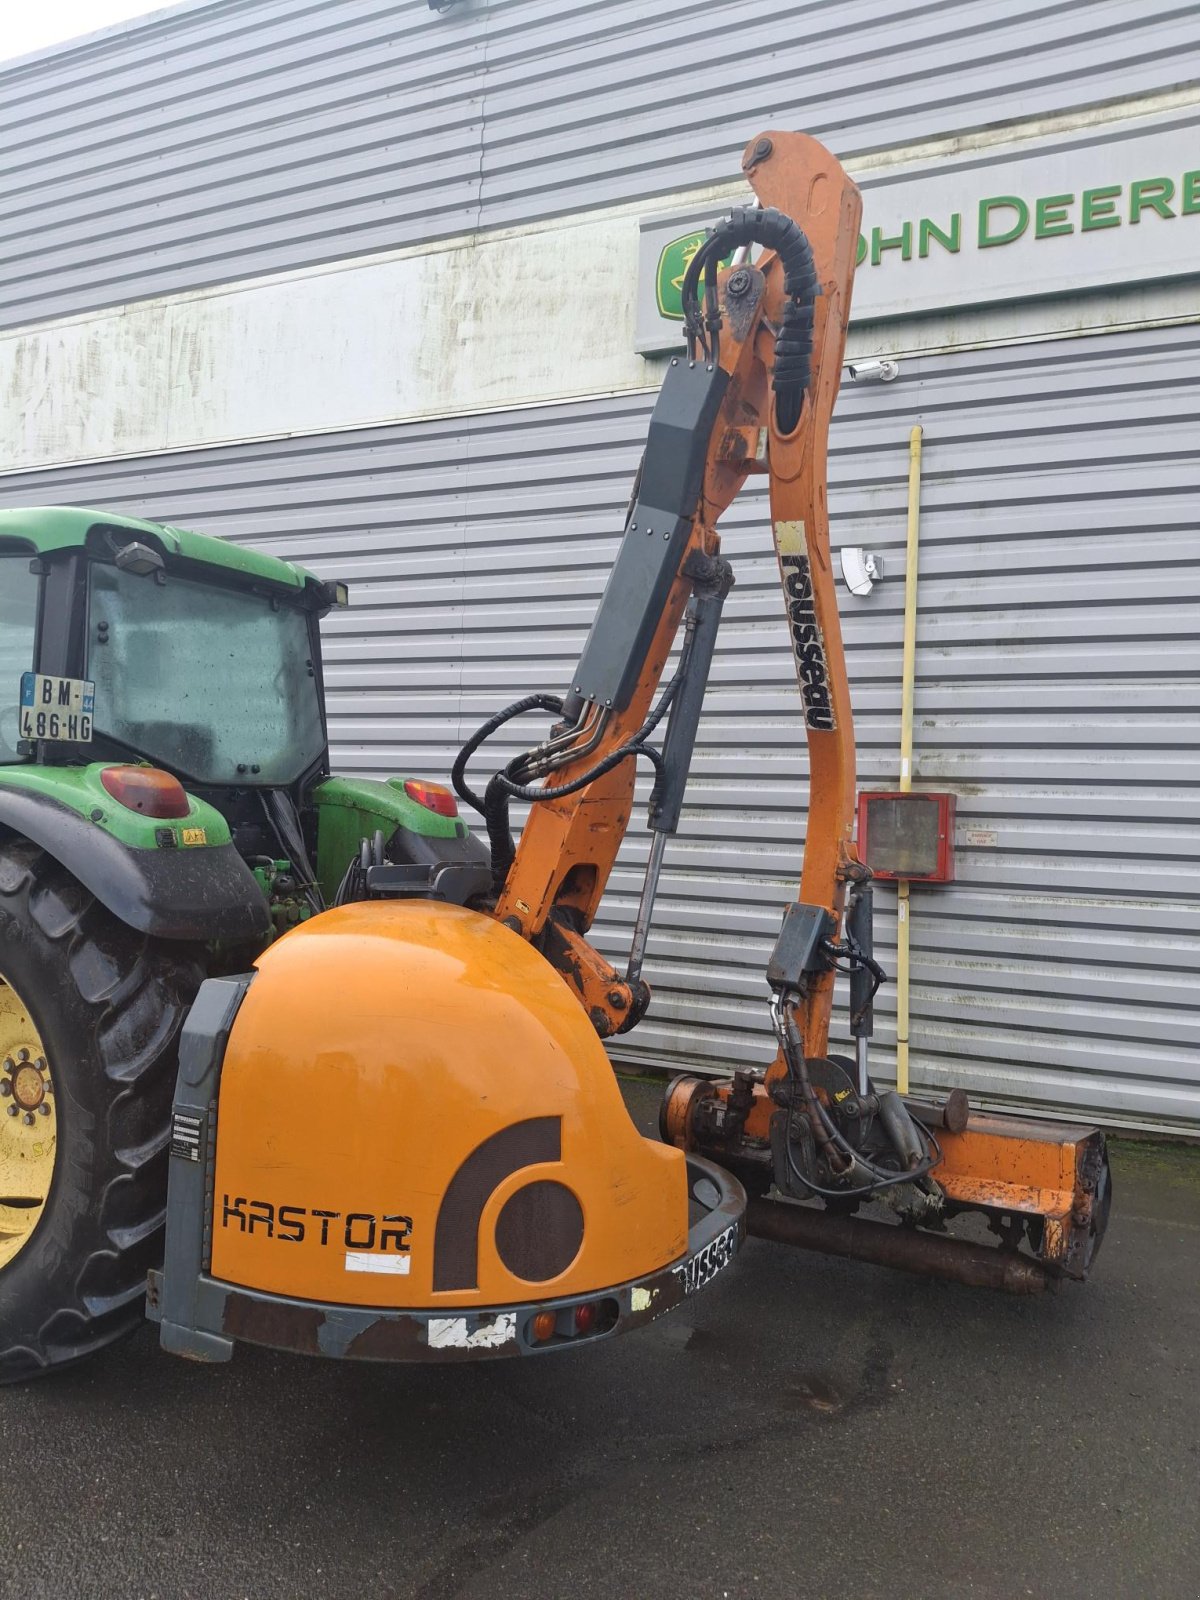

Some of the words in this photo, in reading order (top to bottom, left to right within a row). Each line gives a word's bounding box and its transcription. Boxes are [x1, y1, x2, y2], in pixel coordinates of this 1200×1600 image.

[781, 555, 835, 730] rousseau
[23, 711, 91, 740] 486-HG
[223, 1194, 413, 1251] KASTOR
